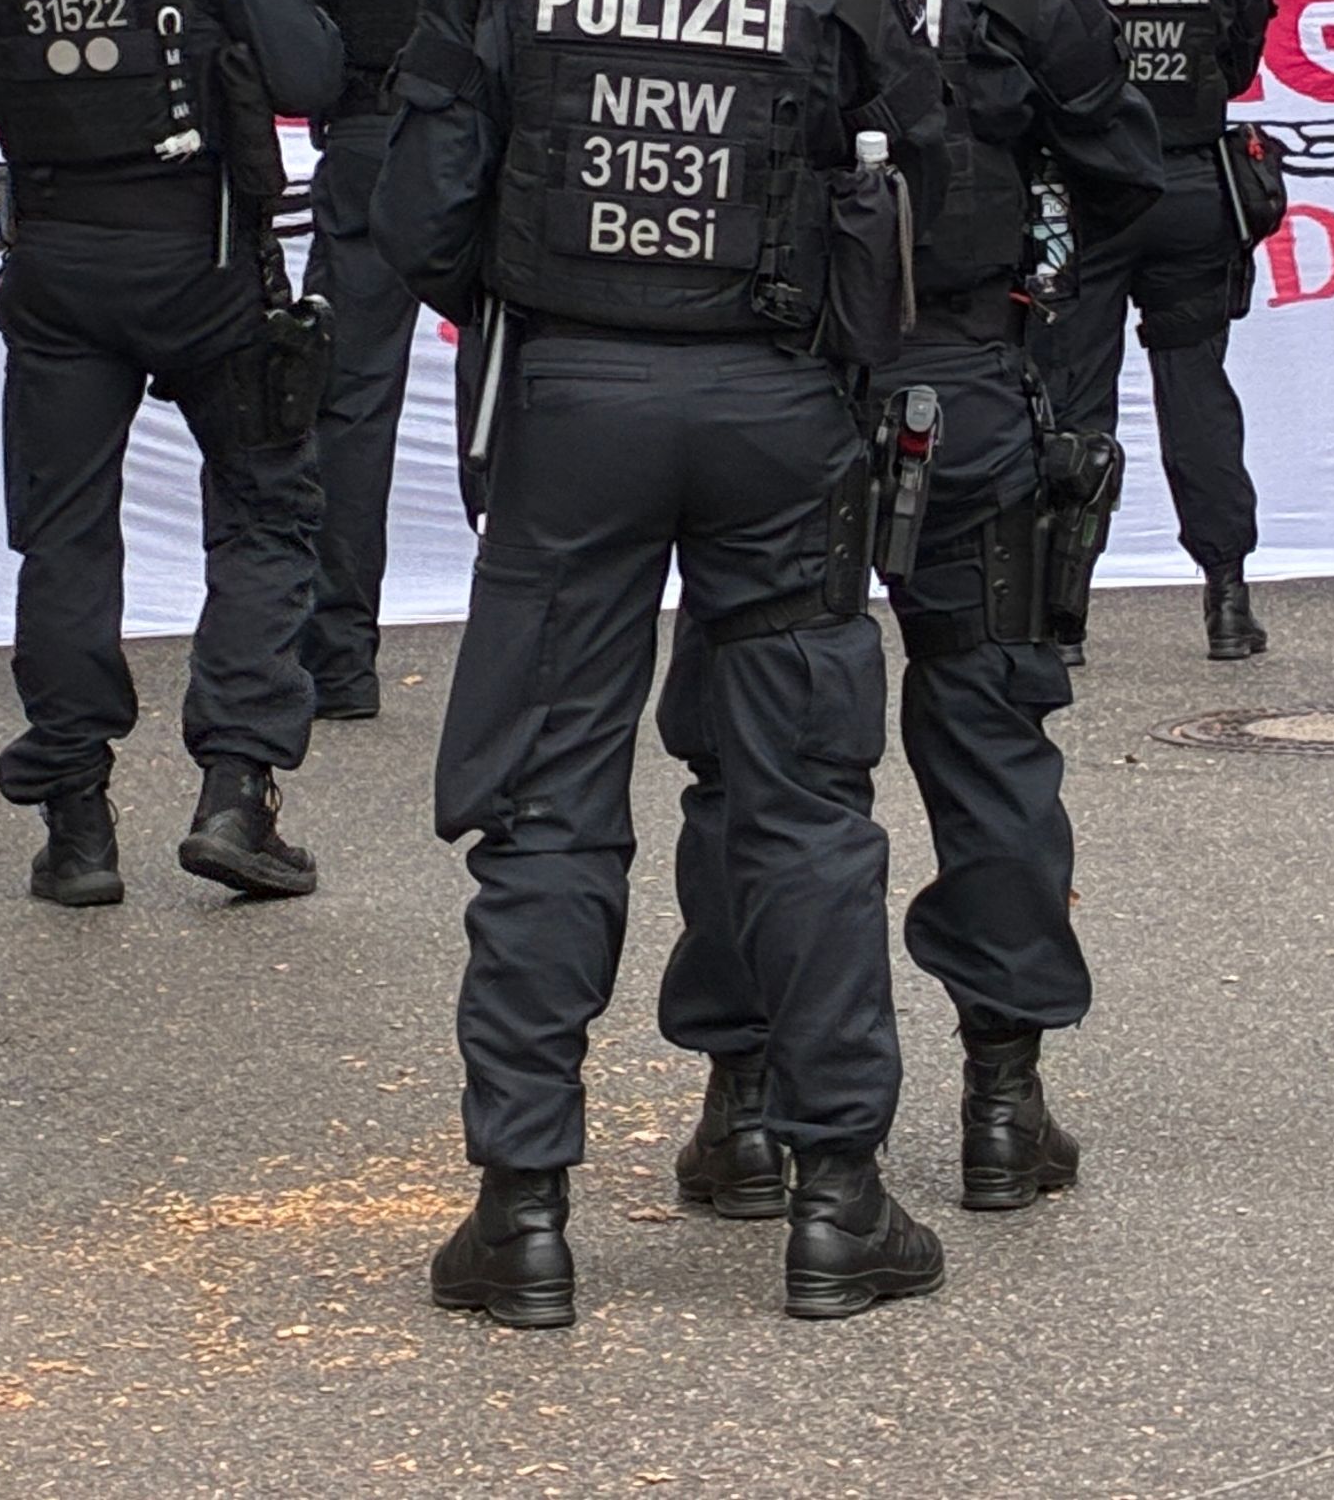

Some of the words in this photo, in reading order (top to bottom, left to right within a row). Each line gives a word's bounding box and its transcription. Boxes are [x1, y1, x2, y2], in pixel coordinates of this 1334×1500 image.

[1128, 53, 1187, 80] 1522
[590, 73, 736, 134] NRW
[581, 136, 730, 199] 31531
[589, 201, 716, 260] BeSi
